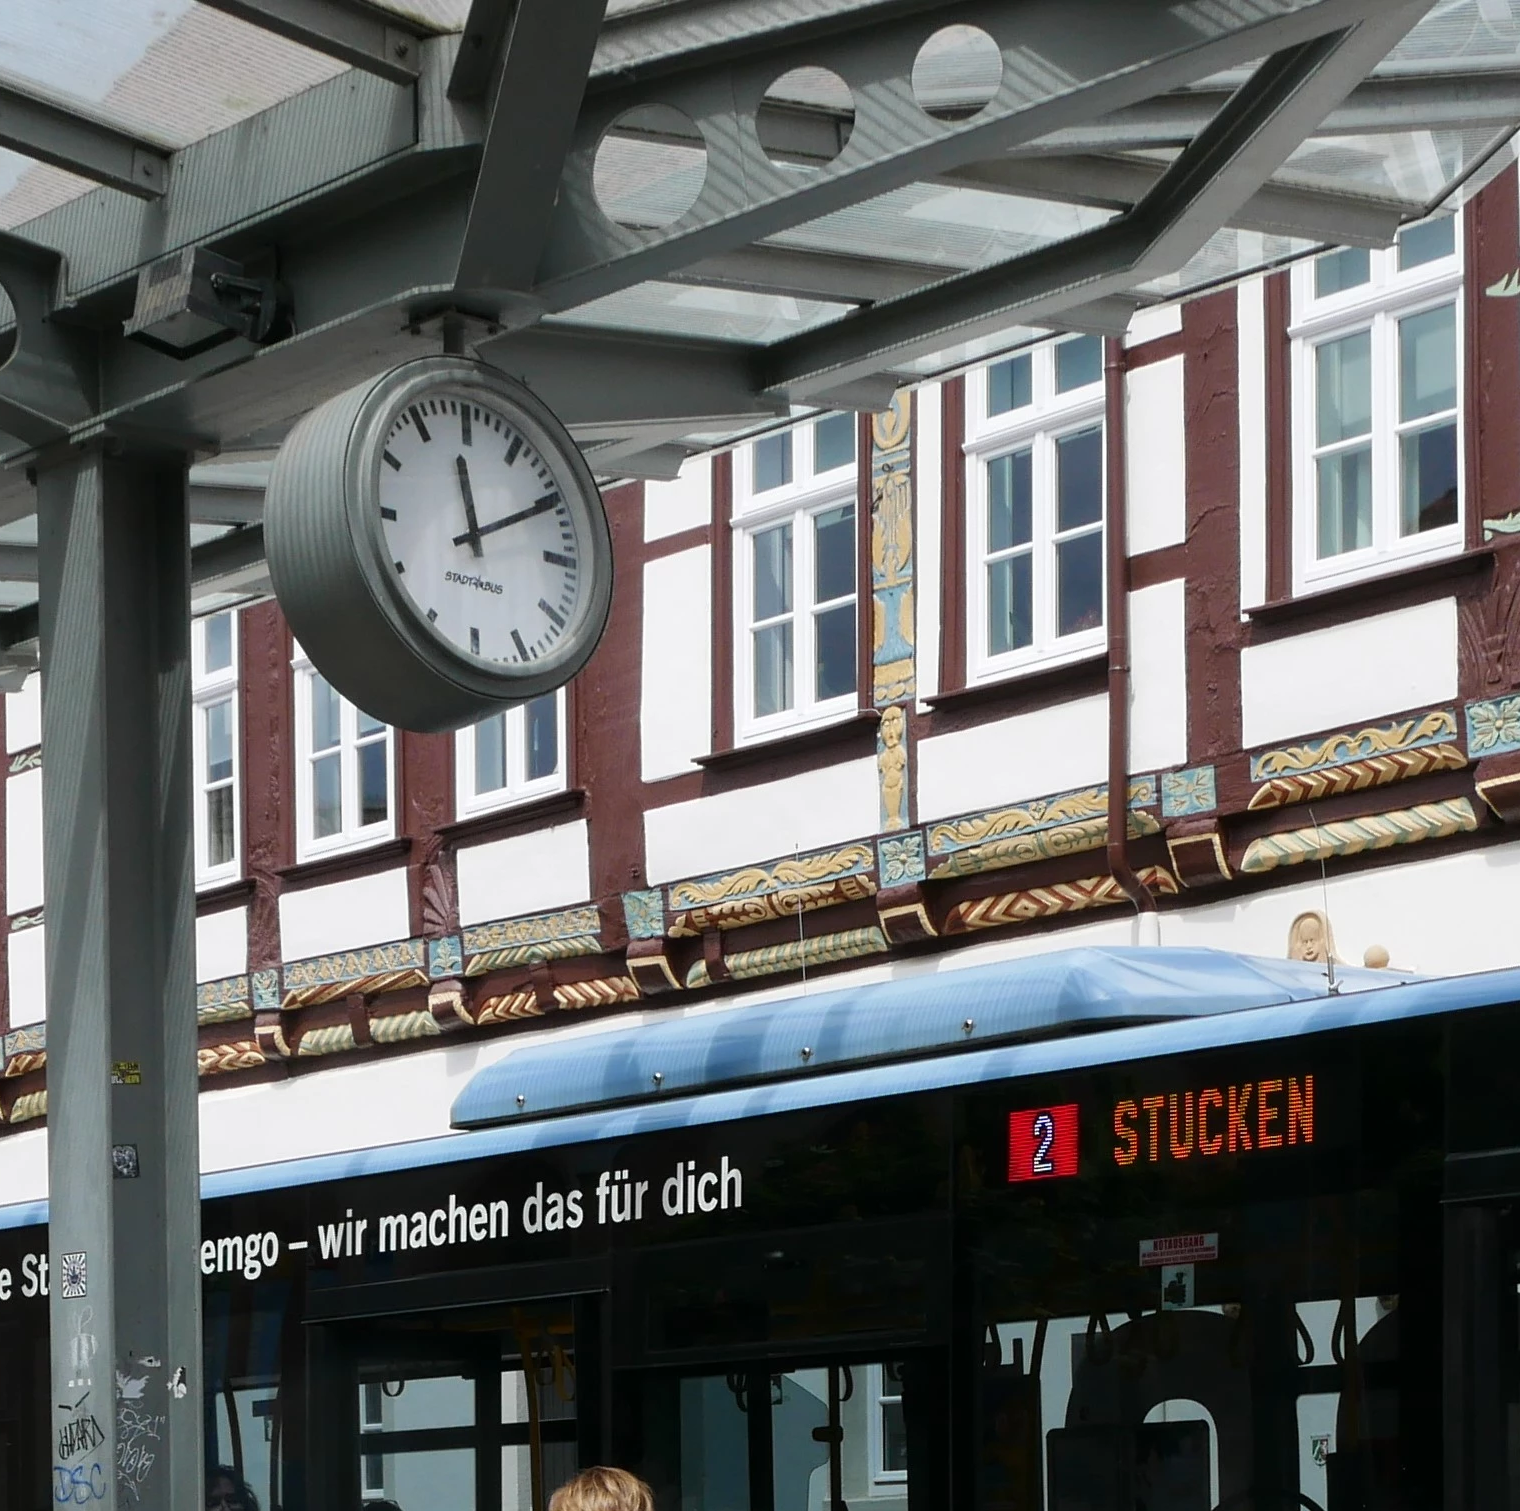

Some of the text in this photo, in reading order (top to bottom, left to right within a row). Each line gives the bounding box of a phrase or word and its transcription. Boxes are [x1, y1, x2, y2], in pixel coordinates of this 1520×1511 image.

[445, 571, 503, 594] STADT BUS
[1034, 1074, 1313, 1172] 2 STUCKEN
[21, 1253, 50, 1298] St
[200, 1231, 279, 1280] emgo
[317, 1209, 369, 1259] wir
[379, 1194, 509, 1252] machen
[522, 1181, 584, 1234] das
[595, 1170, 649, 1225] für
[662, 1155, 743, 1217] dich
[1153, 1236, 1205, 1251] NOTAUSGANG
